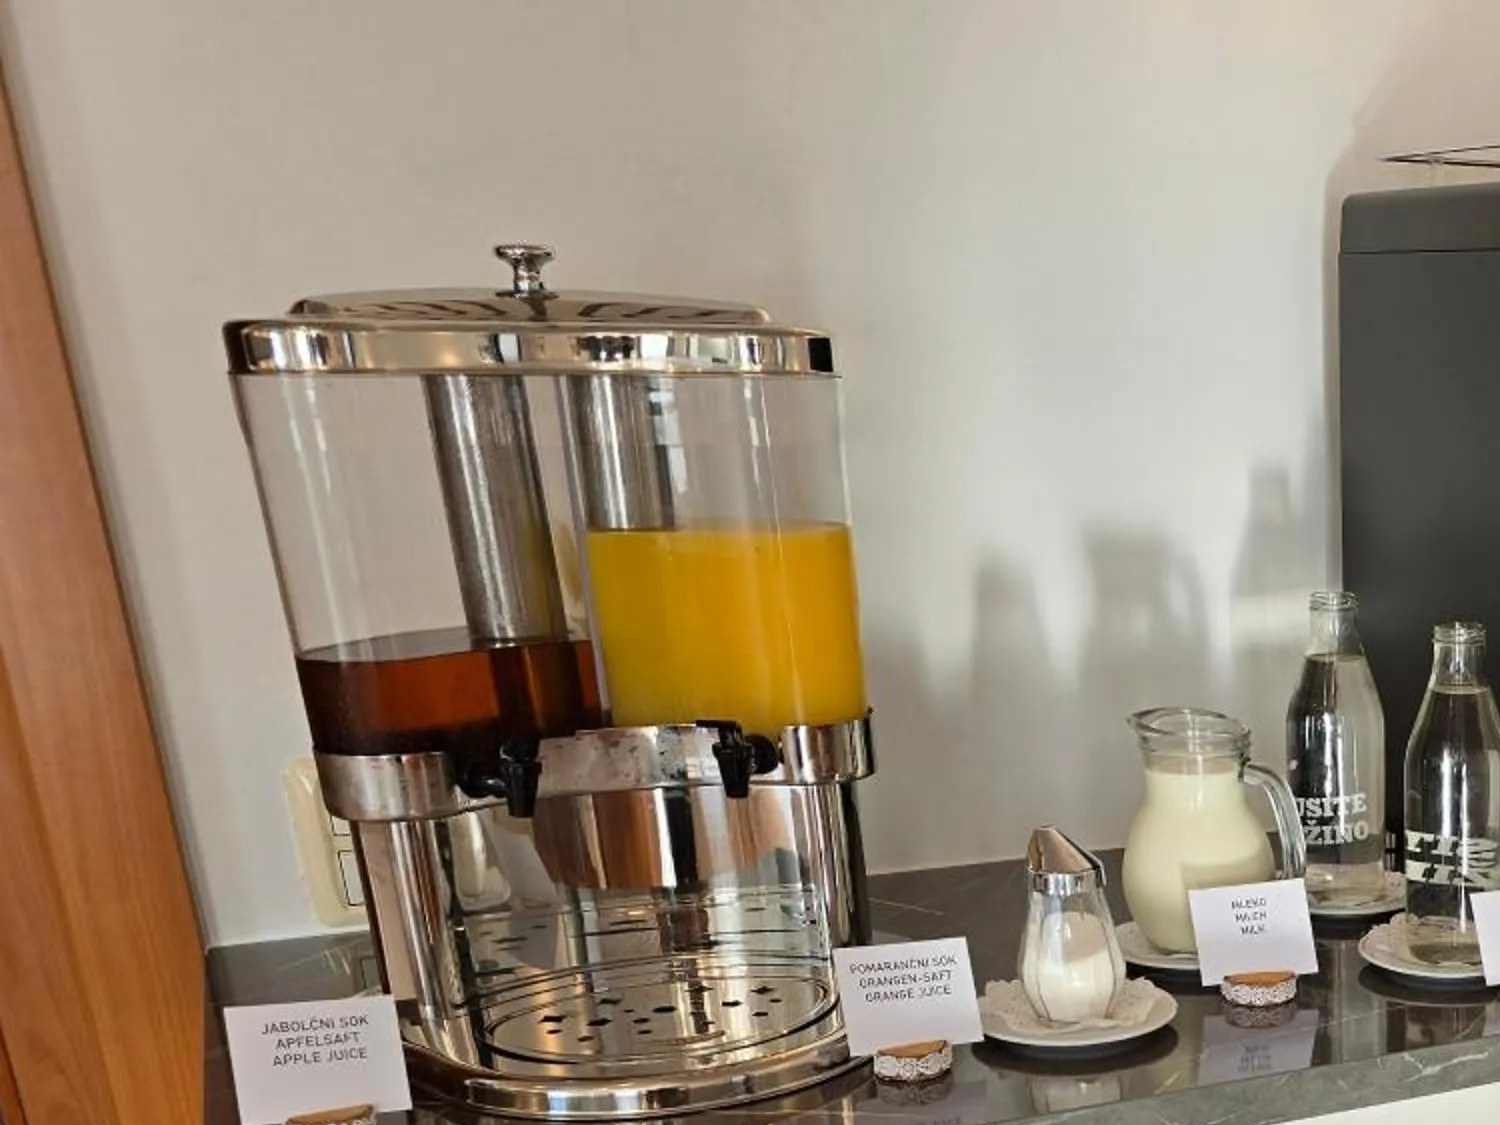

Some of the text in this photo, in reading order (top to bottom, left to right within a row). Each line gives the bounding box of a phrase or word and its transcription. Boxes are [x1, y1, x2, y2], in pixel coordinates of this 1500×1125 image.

[864, 987, 915, 1003] ORANGE
[339, 1014, 369, 1029] SOK
[275, 1031, 361, 1049] APFELSAFT
[273, 1046, 368, 1067] APPLE JUICE
